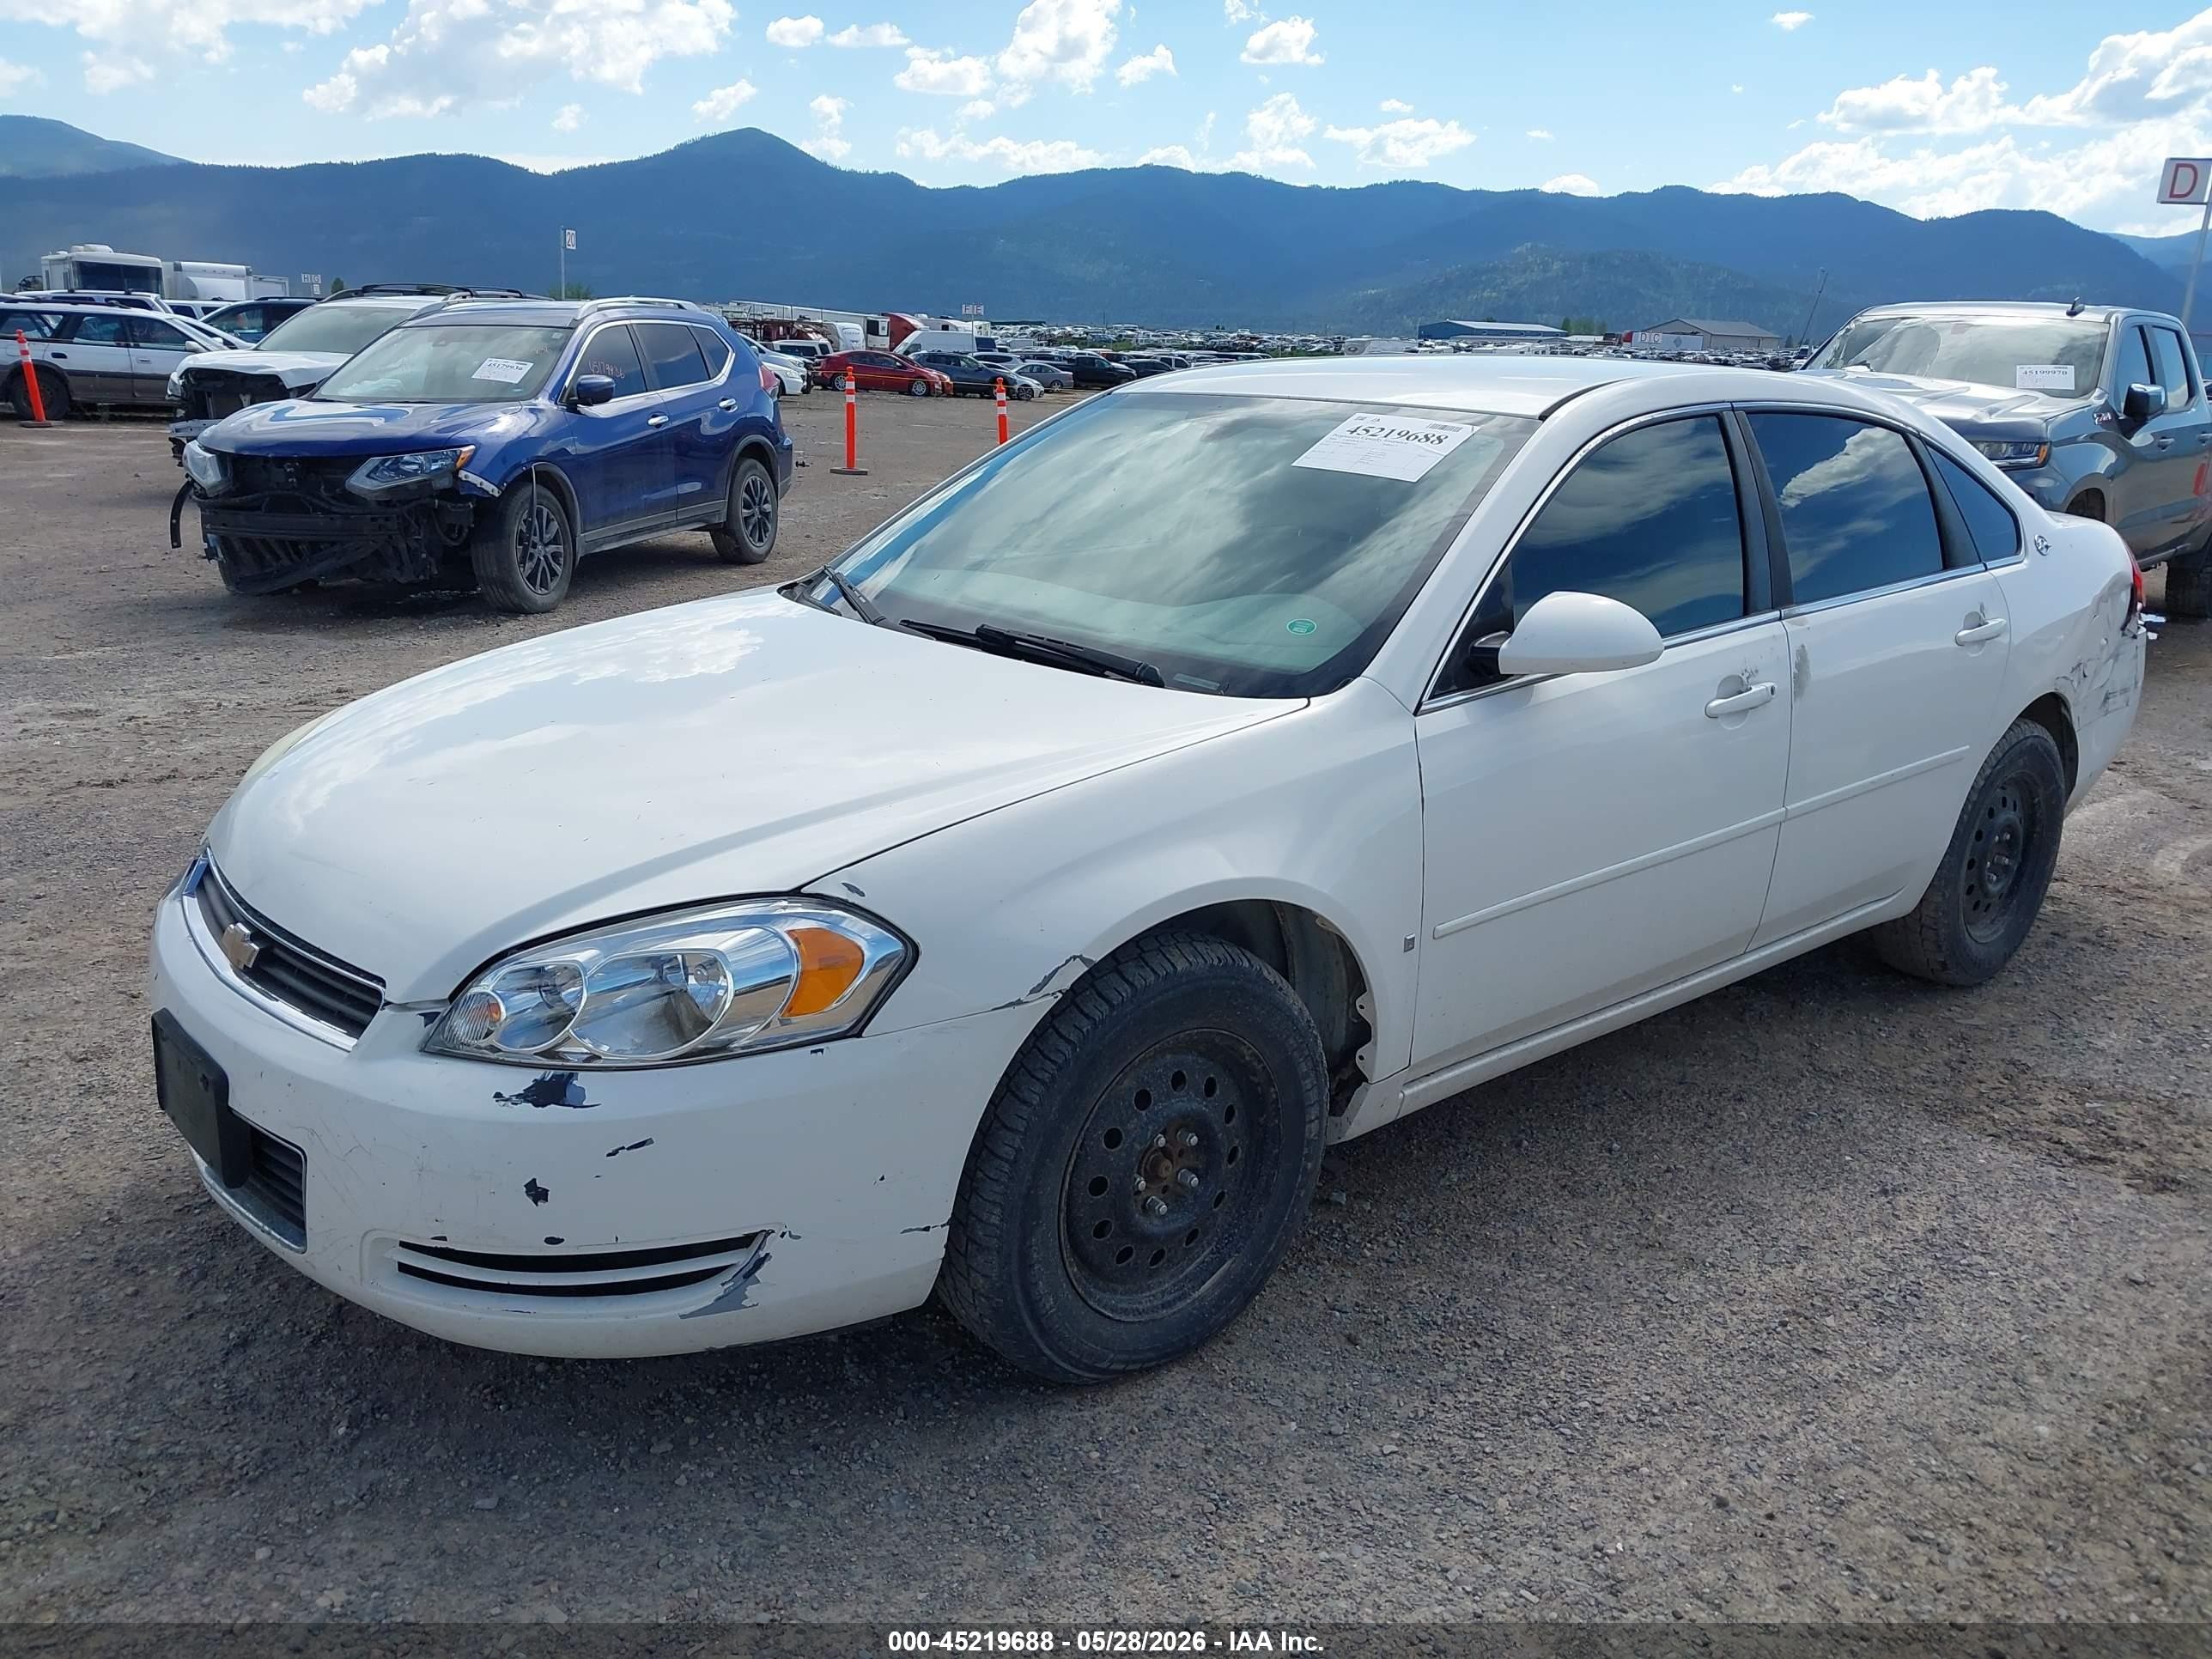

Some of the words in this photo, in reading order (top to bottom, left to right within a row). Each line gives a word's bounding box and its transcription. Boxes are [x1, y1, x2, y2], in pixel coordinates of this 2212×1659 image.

[2169, 163, 2198, 198] D
[567, 232, 575, 248] 20
[975, 305, 982, 314] E
[1640, 332, 1647, 342] D
[1653, 333, 1661, 343] C
[1346, 425, 1449, 445] 45219688
